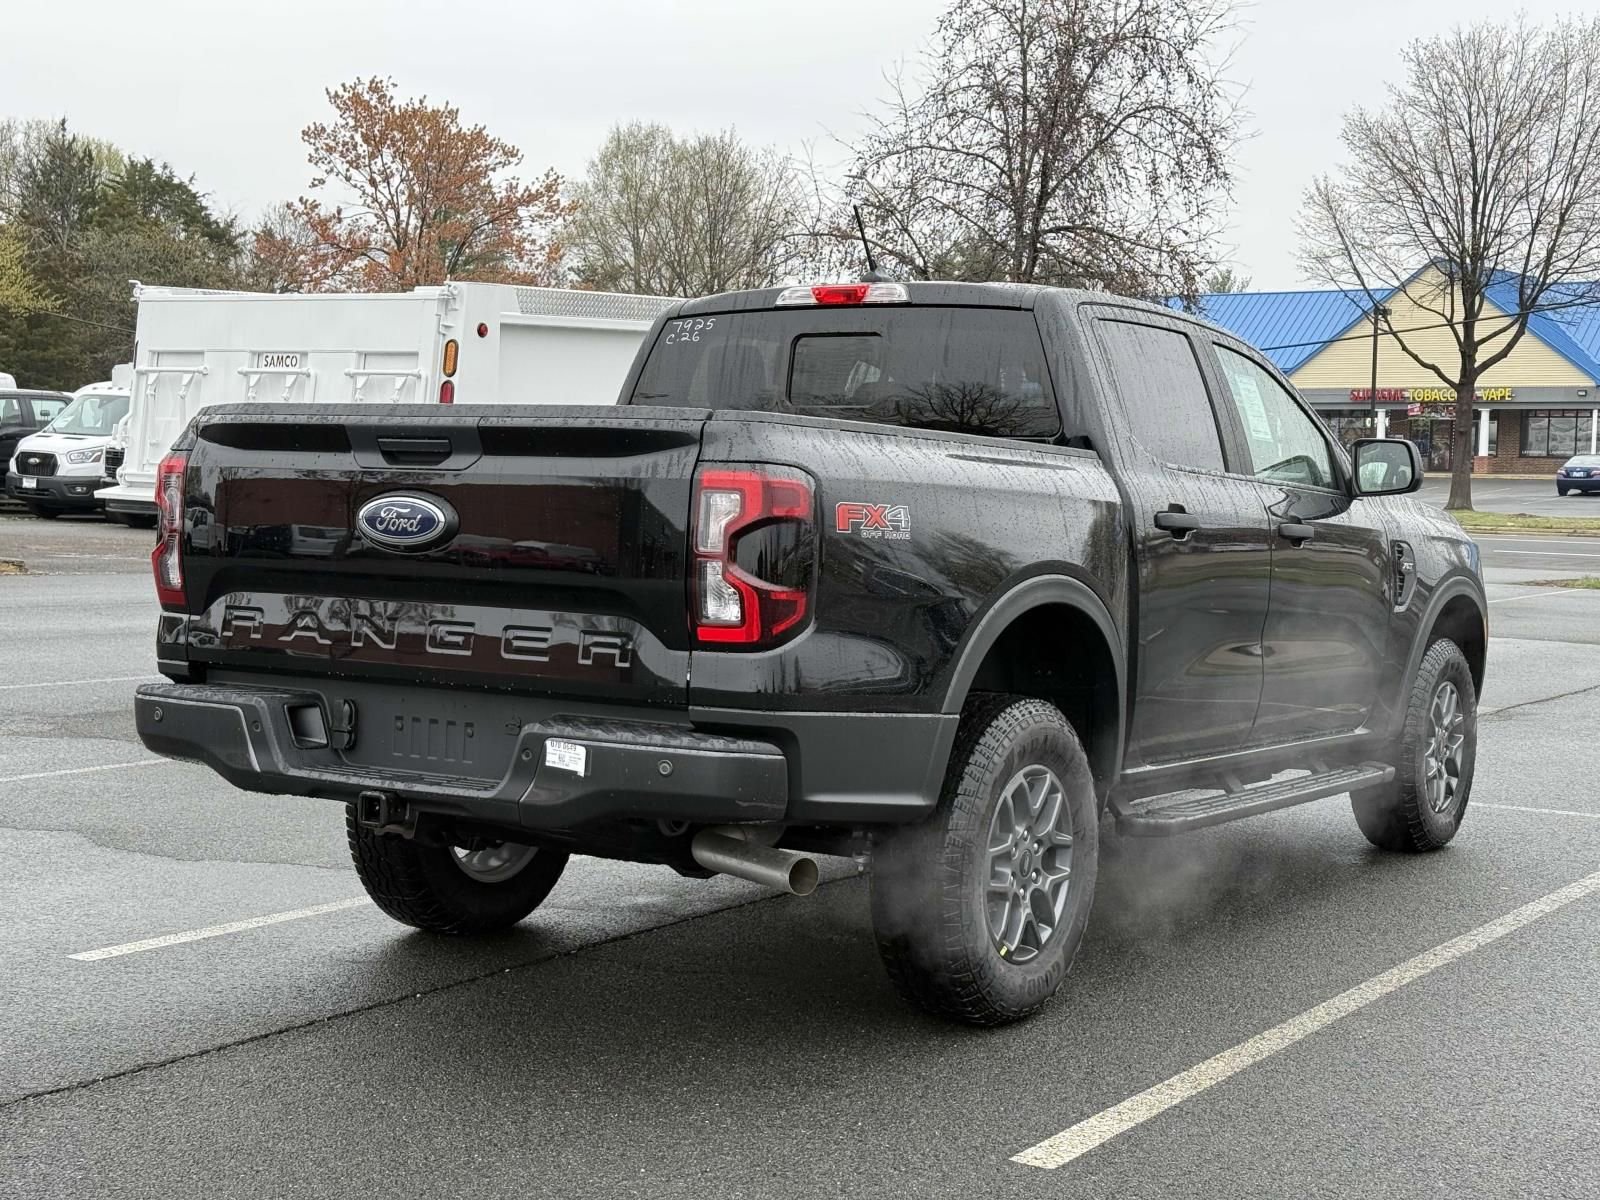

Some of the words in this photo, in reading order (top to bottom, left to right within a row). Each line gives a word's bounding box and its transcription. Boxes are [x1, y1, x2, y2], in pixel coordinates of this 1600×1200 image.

[673, 318, 716, 333] 7925
[264, 355, 298, 367] SAMCO
[1407, 388, 1457, 401] TOBACC
[1481, 387, 1512, 401] VAPE
[375, 505, 422, 533] Ford
[836, 502, 911, 533] FX4
[861, 530, 882, 539] OFF
[222, 605, 633, 667] RANGER
